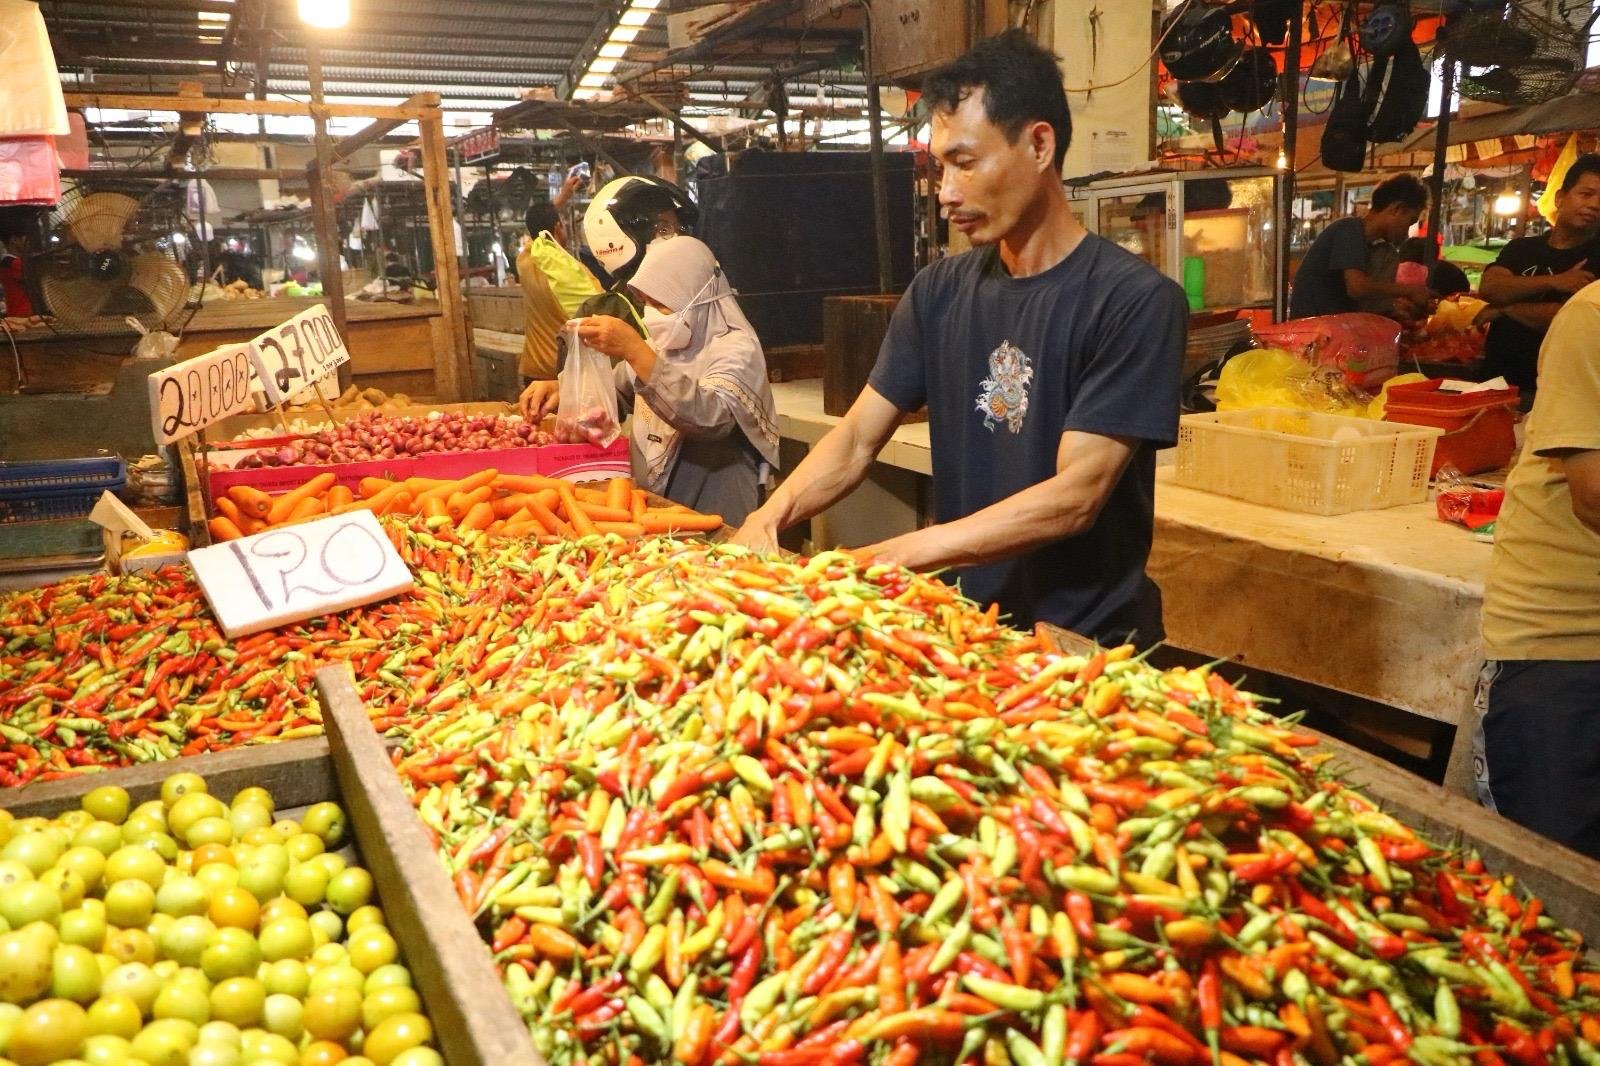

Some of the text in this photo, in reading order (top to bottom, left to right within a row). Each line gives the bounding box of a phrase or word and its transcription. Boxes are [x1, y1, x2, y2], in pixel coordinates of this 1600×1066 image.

[160, 352, 248, 436] 20.000
[258, 314, 341, 393] 27.000
[229, 522, 386, 611] 120
